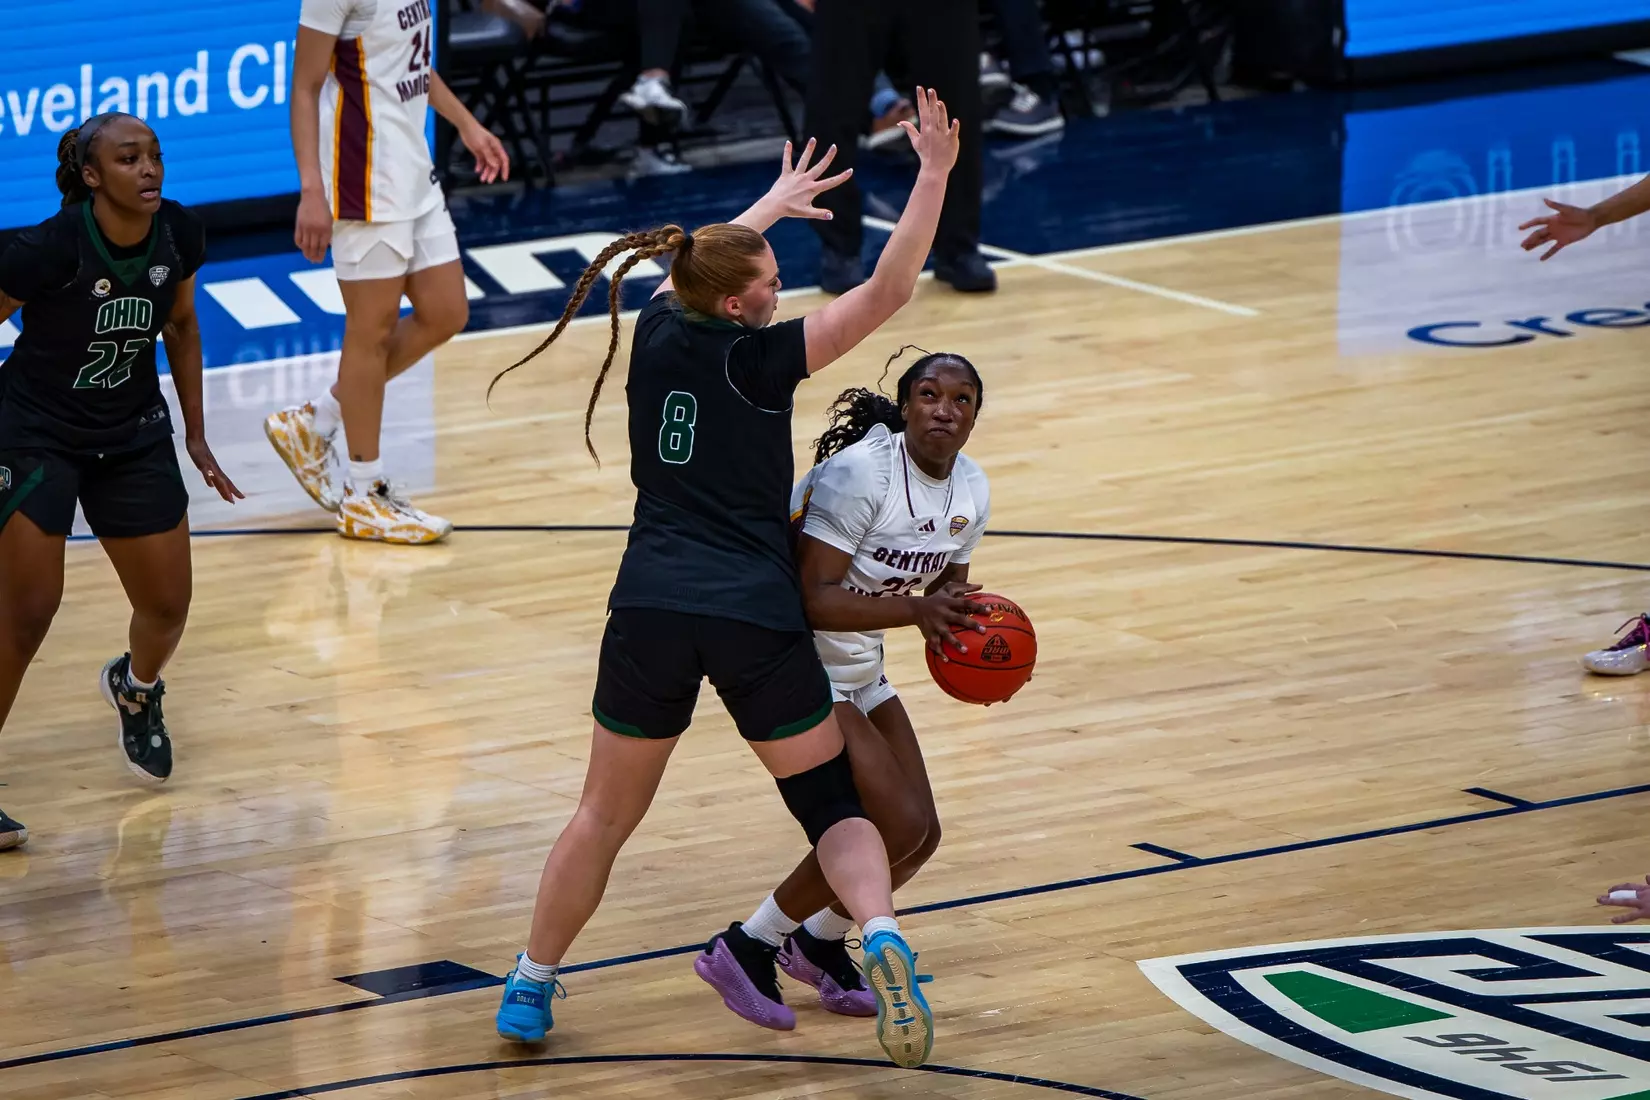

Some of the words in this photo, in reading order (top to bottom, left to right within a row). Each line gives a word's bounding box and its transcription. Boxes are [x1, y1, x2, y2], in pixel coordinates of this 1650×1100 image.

[408, 24, 431, 73] 24
[227, 40, 297, 110] Cl
[95, 297, 153, 334] OHIO
[1406, 302, 1650, 347] Cre
[658, 390, 697, 464] 8
[872, 546, 947, 574] CENTRAL
[1402, 1033, 1631, 1083] 1946
